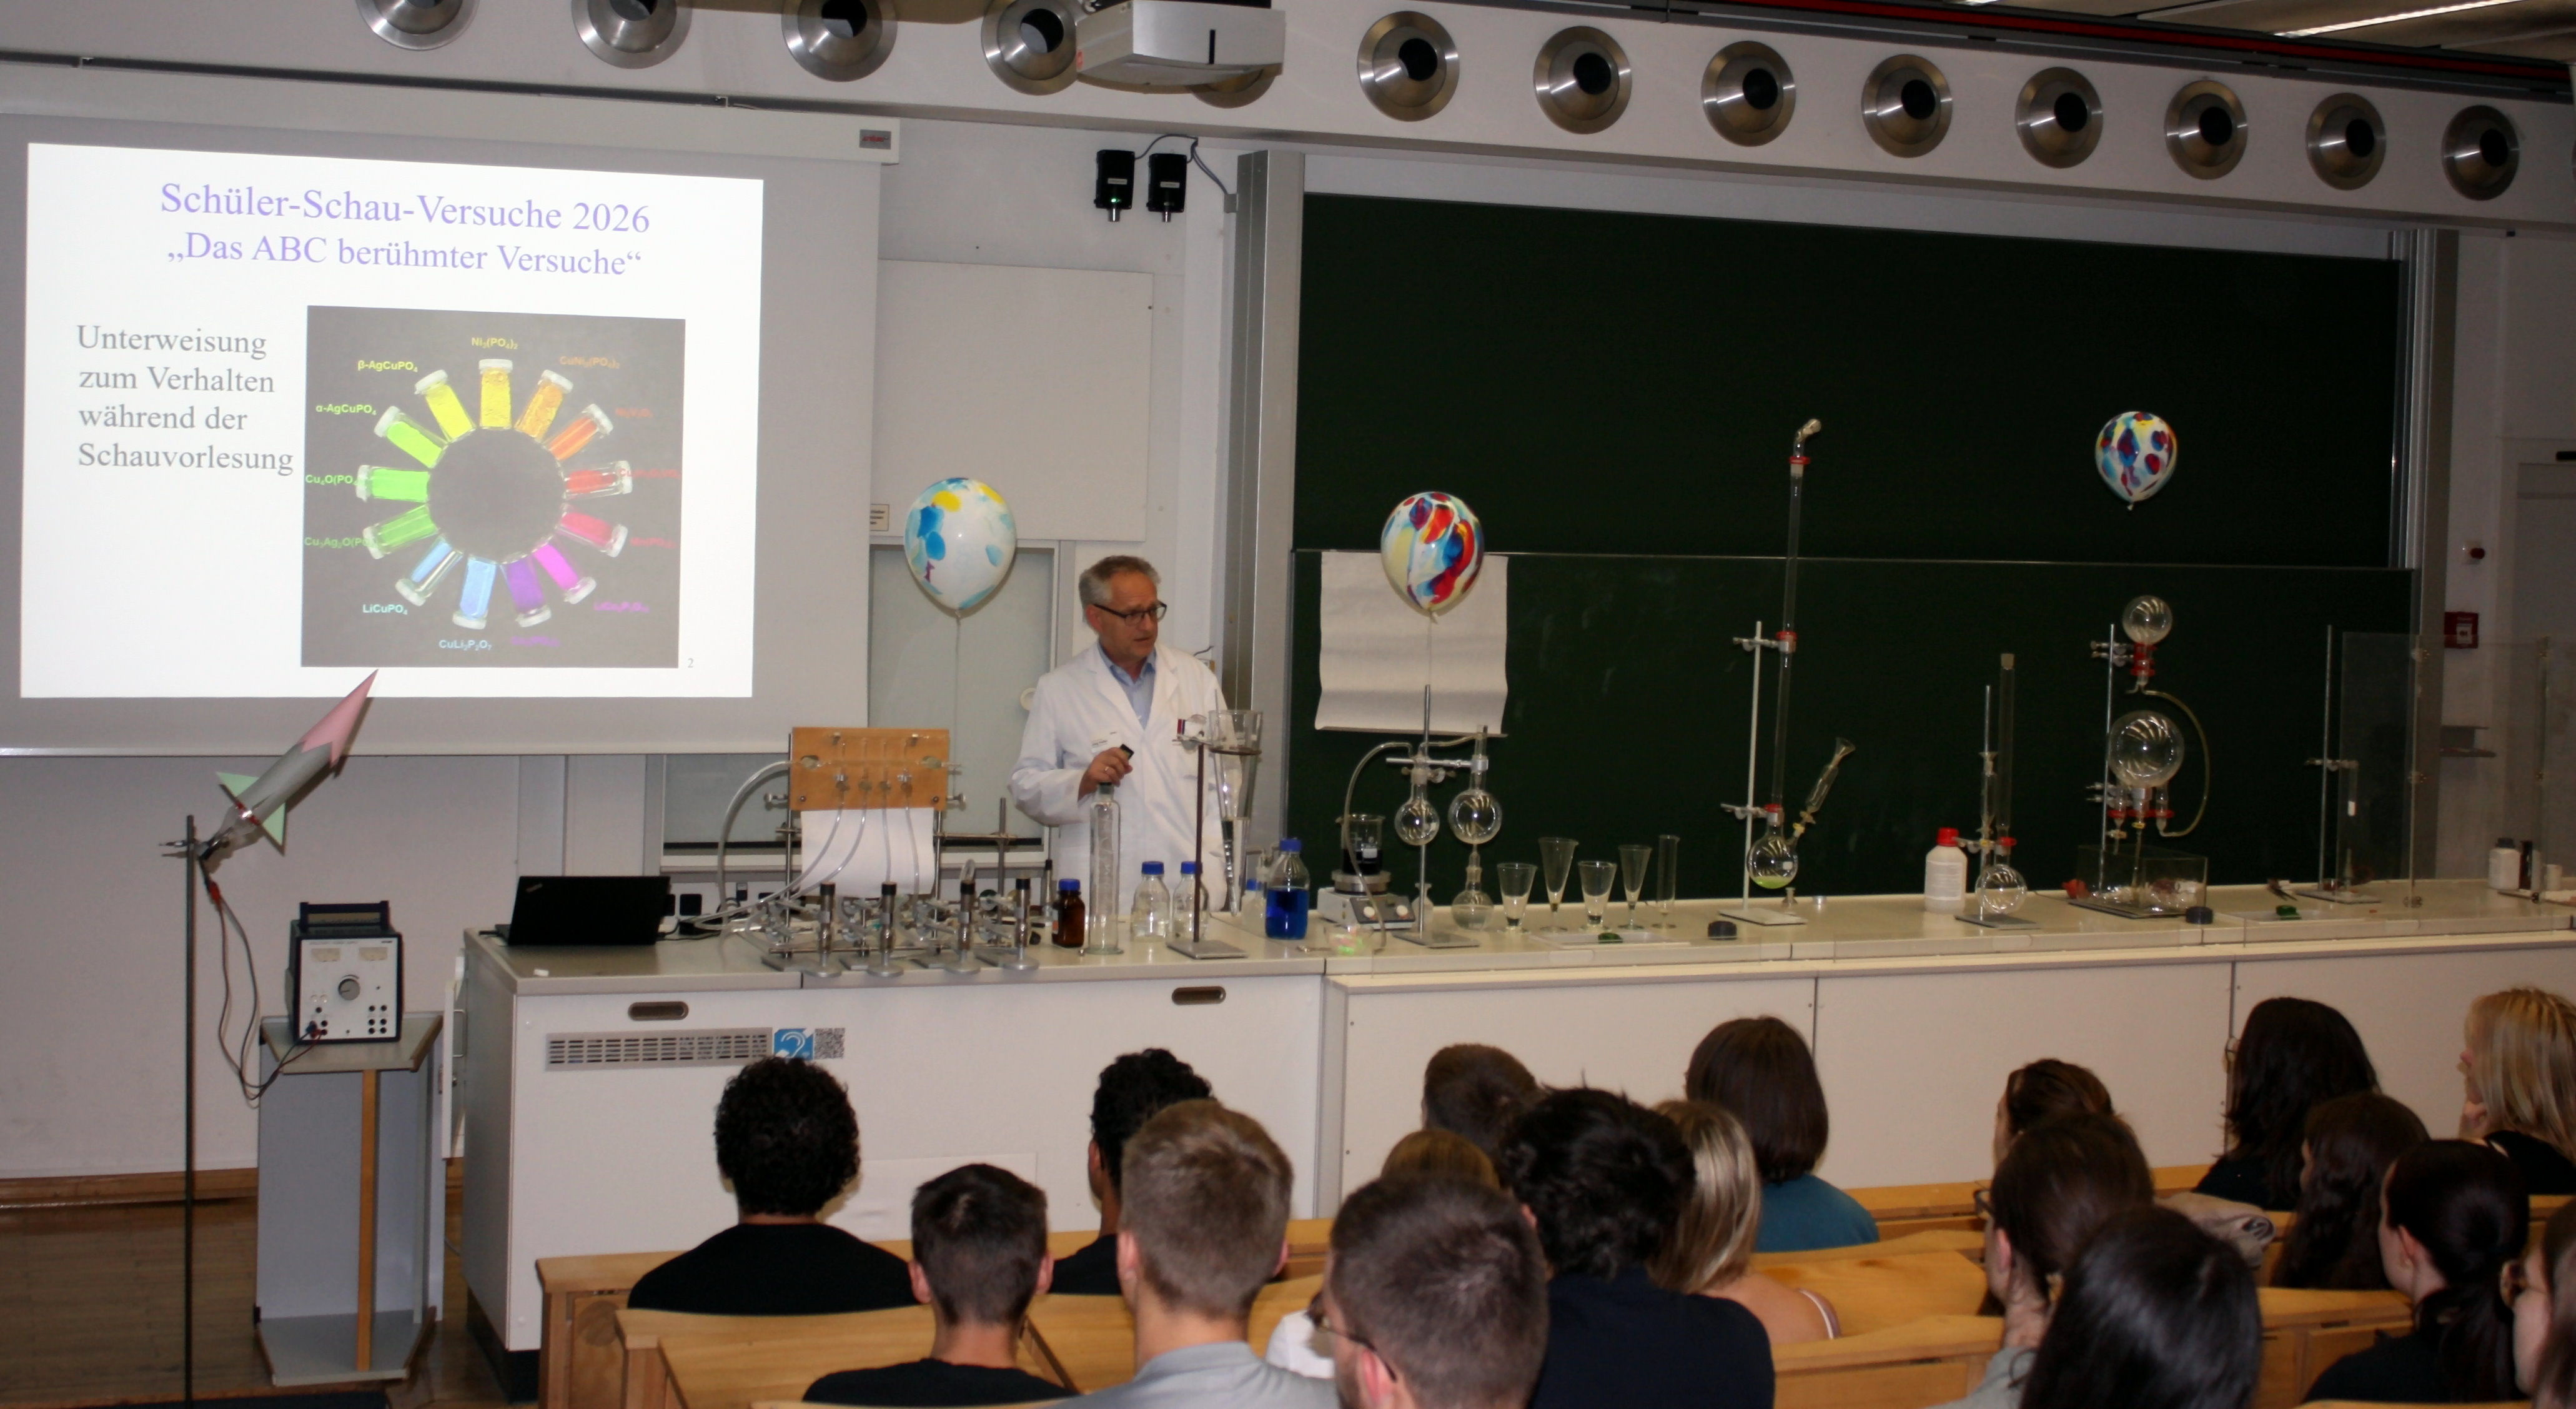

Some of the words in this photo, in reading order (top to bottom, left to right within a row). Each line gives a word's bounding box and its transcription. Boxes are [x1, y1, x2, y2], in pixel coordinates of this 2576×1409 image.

[161, 182, 562, 229] Schüler-Schau-Versuche
[573, 202, 650, 233] 2026
[167, 232, 243, 262] „Das
[252, 236, 327, 263] ABC
[337, 237, 488, 269] berühmter
[497, 245, 642, 276] Versuche“
[76, 324, 267, 361] Unterweisung
[79, 371, 137, 389] zum
[146, 366, 275, 394] Verhalten
[78, 403, 196, 429] während
[205, 405, 248, 430] der
[78, 442, 294, 477] Schauvorlesung
[687, 657, 695, 669] 2
